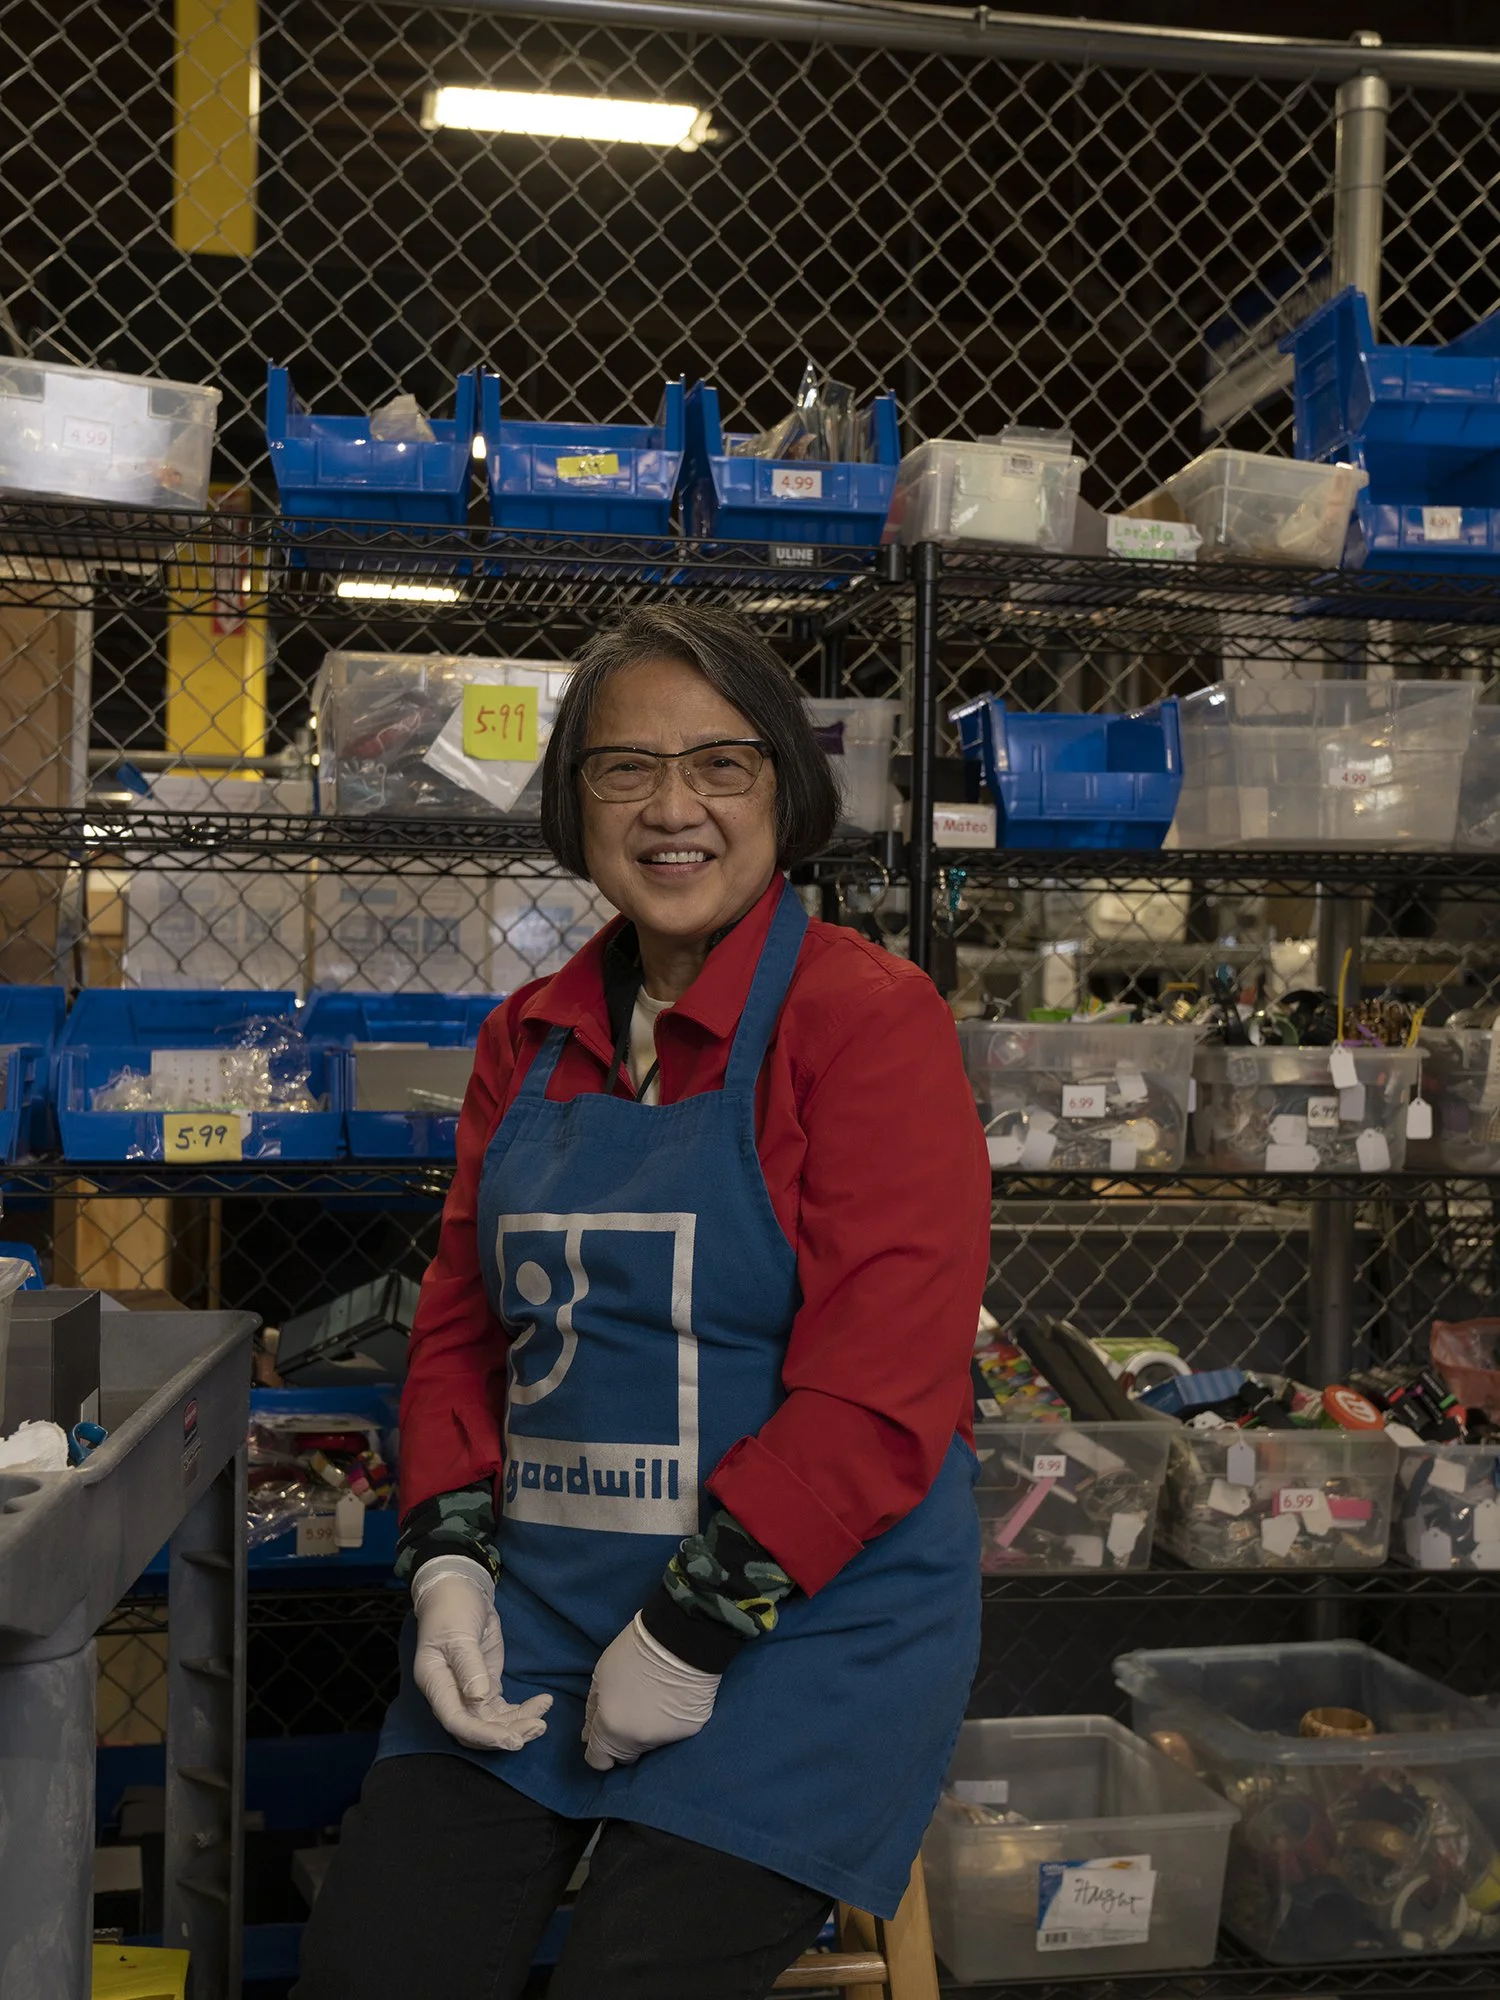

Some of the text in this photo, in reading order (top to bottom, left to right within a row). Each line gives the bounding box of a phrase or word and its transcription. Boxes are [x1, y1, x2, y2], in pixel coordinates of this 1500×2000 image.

[782, 475, 814, 490] 4.99
[776, 548, 814, 560] ULINE
[474, 703, 525, 743] 5.99
[943, 819, 988, 834] Mateo
[175, 1125, 228, 1150] 5.99
[506, 1455, 679, 1504] goodwill
[1283, 1494, 1314, 1509] 6.99
